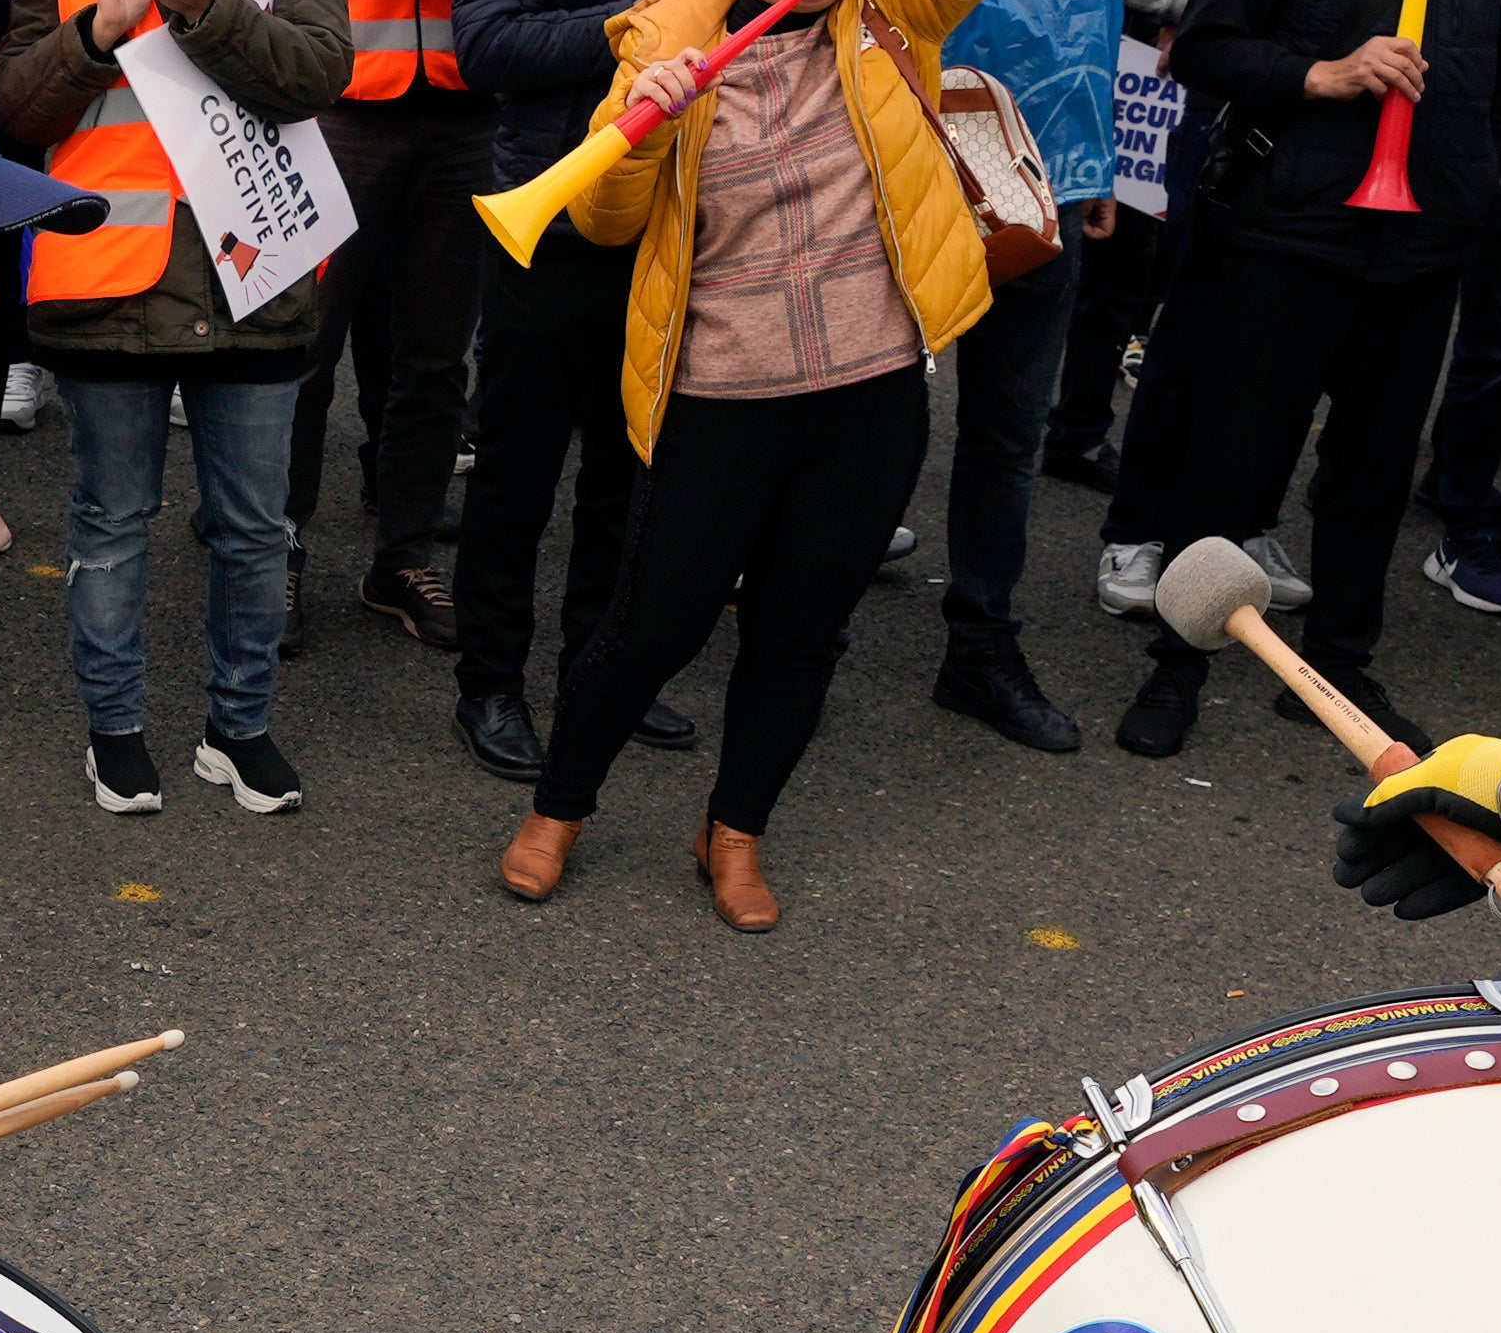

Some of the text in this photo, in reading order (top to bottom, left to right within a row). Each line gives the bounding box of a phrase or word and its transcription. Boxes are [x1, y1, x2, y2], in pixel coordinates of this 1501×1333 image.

[200, 94, 274, 245] COLECTIVE
[1375, 1001, 1459, 1024] ROMANIA
[1191, 1042, 1272, 1082] ROMANIA
